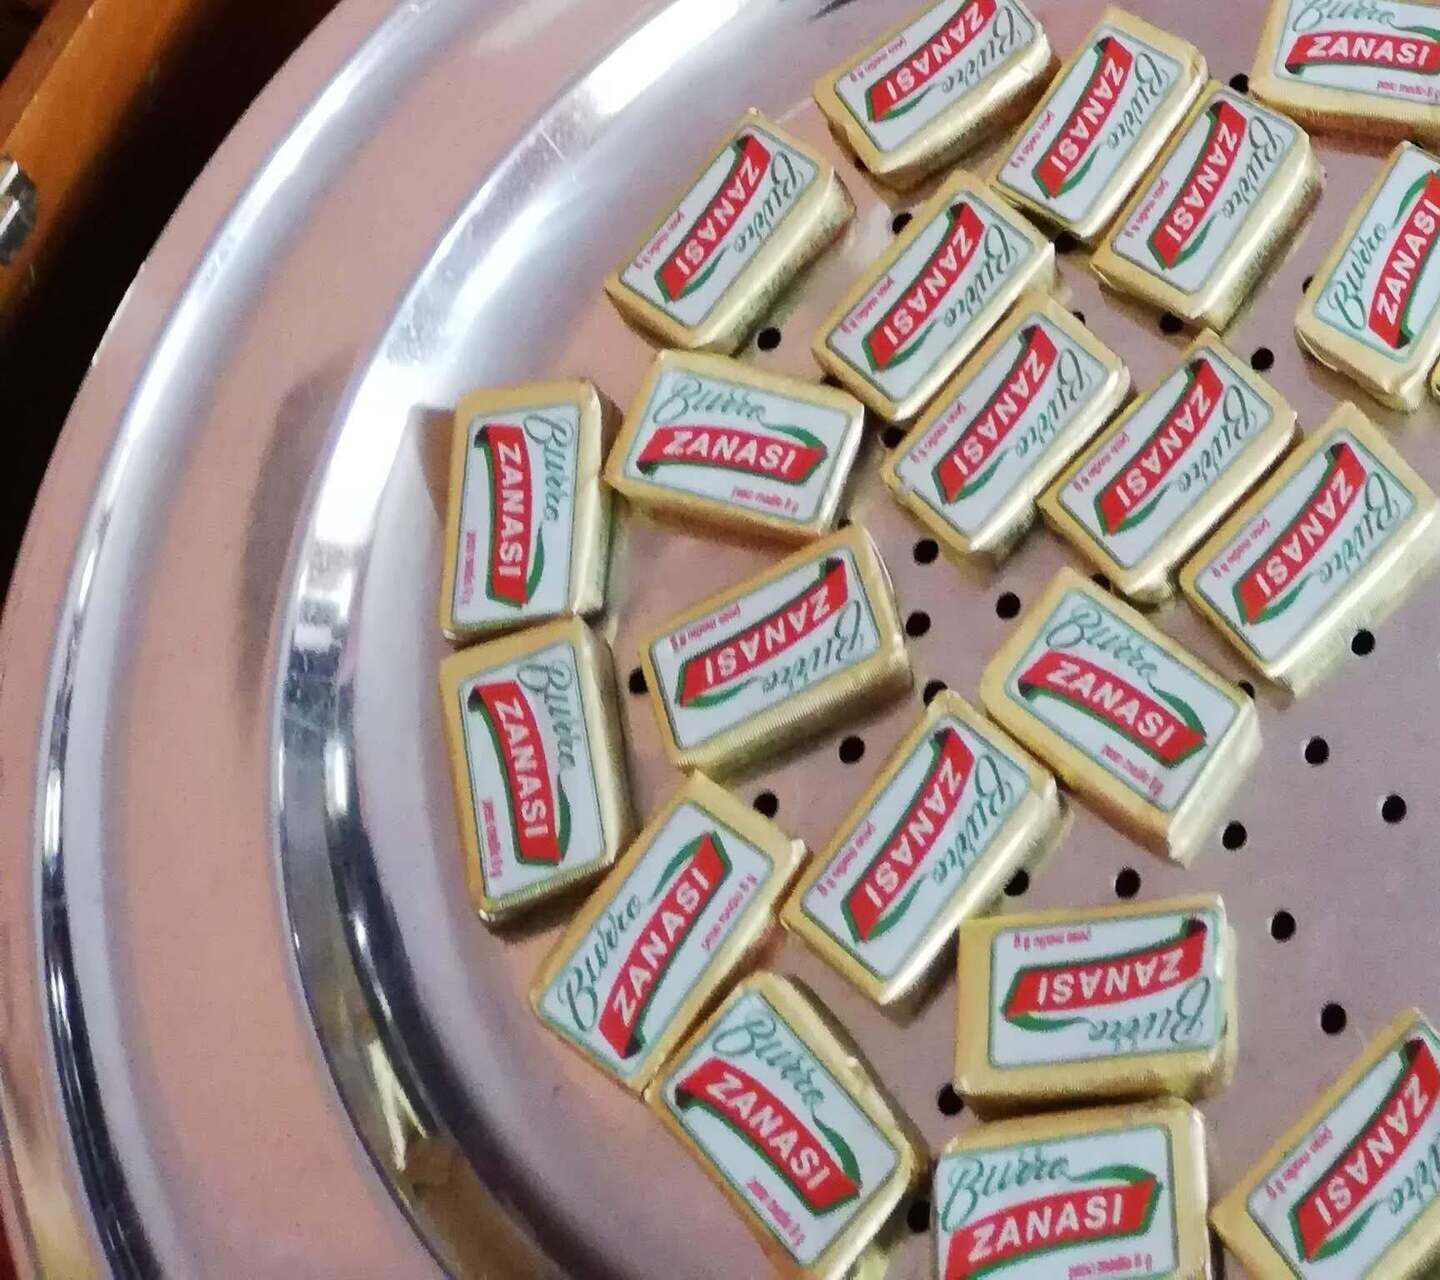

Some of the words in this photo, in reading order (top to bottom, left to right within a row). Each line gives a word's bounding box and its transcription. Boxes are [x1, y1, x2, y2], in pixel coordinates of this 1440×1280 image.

[885, 1, 985, 100] ZANASI
[937, 5, 1022, 95] Burro
[1102, 52, 1170, 151] Burro
[1305, 36, 1429, 66] ZANASI
[1049, 56, 1125, 172] ZANASI
[1218, 116, 1284, 219] Burro
[674, 155, 761, 275] ZANASI
[729, 151, 805, 254] Burro
[1164, 121, 1239, 242] ZANASI
[882, 224, 974, 345] ZANASI
[939, 223, 1019, 329] Burro
[1326, 221, 1389, 330] Burro
[660, 430, 797, 473] ZANASI
[951, 348, 1046, 475] ZANASI
[1009, 347, 1093, 458] Burro
[1114, 383, 1212, 507] ZANASI
[1172, 384, 1258, 494] Burro
[496, 442, 525, 575] ZANASI
[522, 416, 575, 524] Burro
[1254, 468, 1354, 596] ZANASI
[1314, 471, 1400, 584] Burro
[705, 584, 830, 685] ZANASI
[758, 598, 864, 694] Burro
[516, 660, 583, 774] Burro
[1044, 658, 1176, 747] ZANASI
[492, 698, 549, 836] ZANASI
[927, 753, 1015, 886] Burro
[863, 756, 963, 908] ZANASI
[555, 893, 646, 1032] Burro
[610, 866, 710, 1027] ZANASI
[1036, 946, 1184, 1005] ZANASI
[704, 1070, 832, 1190] ZANASI
[1313, 1072, 1430, 1225] ZANASI
[946, 1149, 1069, 1230] Burro
[968, 1192, 1122, 1261] ZANASI
